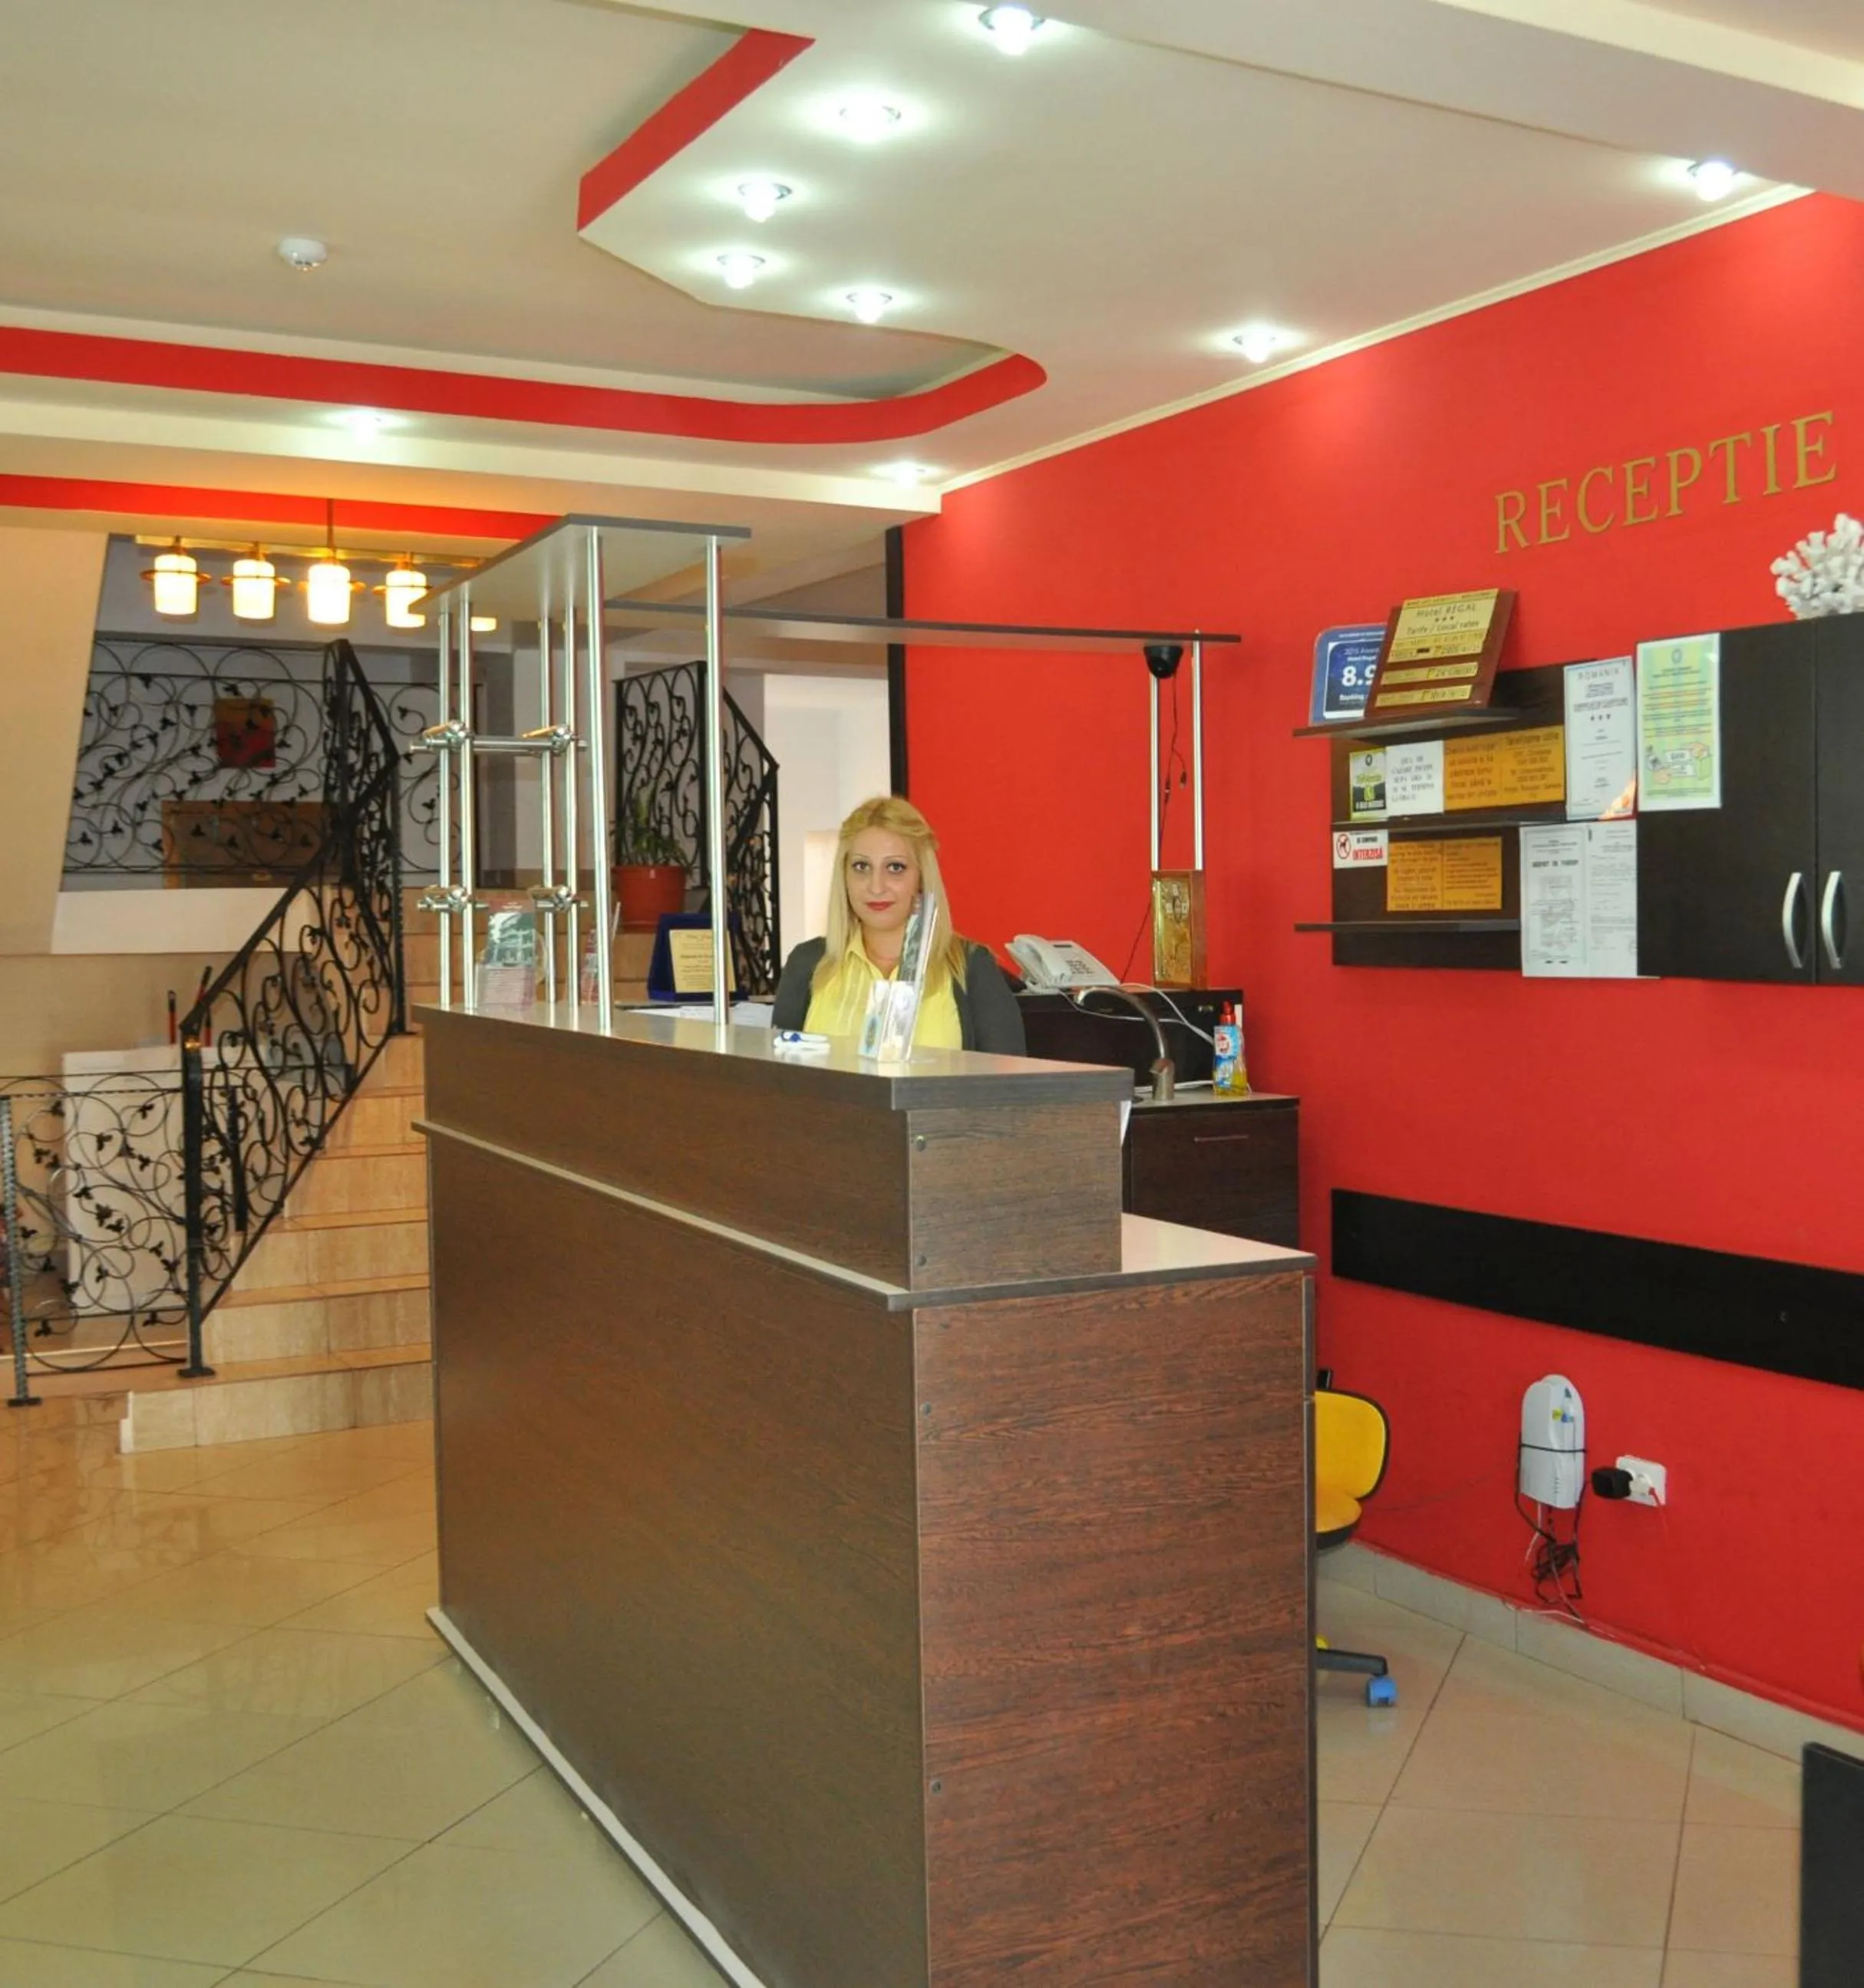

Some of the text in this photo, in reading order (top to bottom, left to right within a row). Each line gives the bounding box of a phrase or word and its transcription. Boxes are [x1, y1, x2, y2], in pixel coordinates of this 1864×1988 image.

[1494, 410, 1837, 554] RECEPTIE
[1417, 607, 1442, 618] Hotel
[1341, 664, 1377, 687] 8.9
